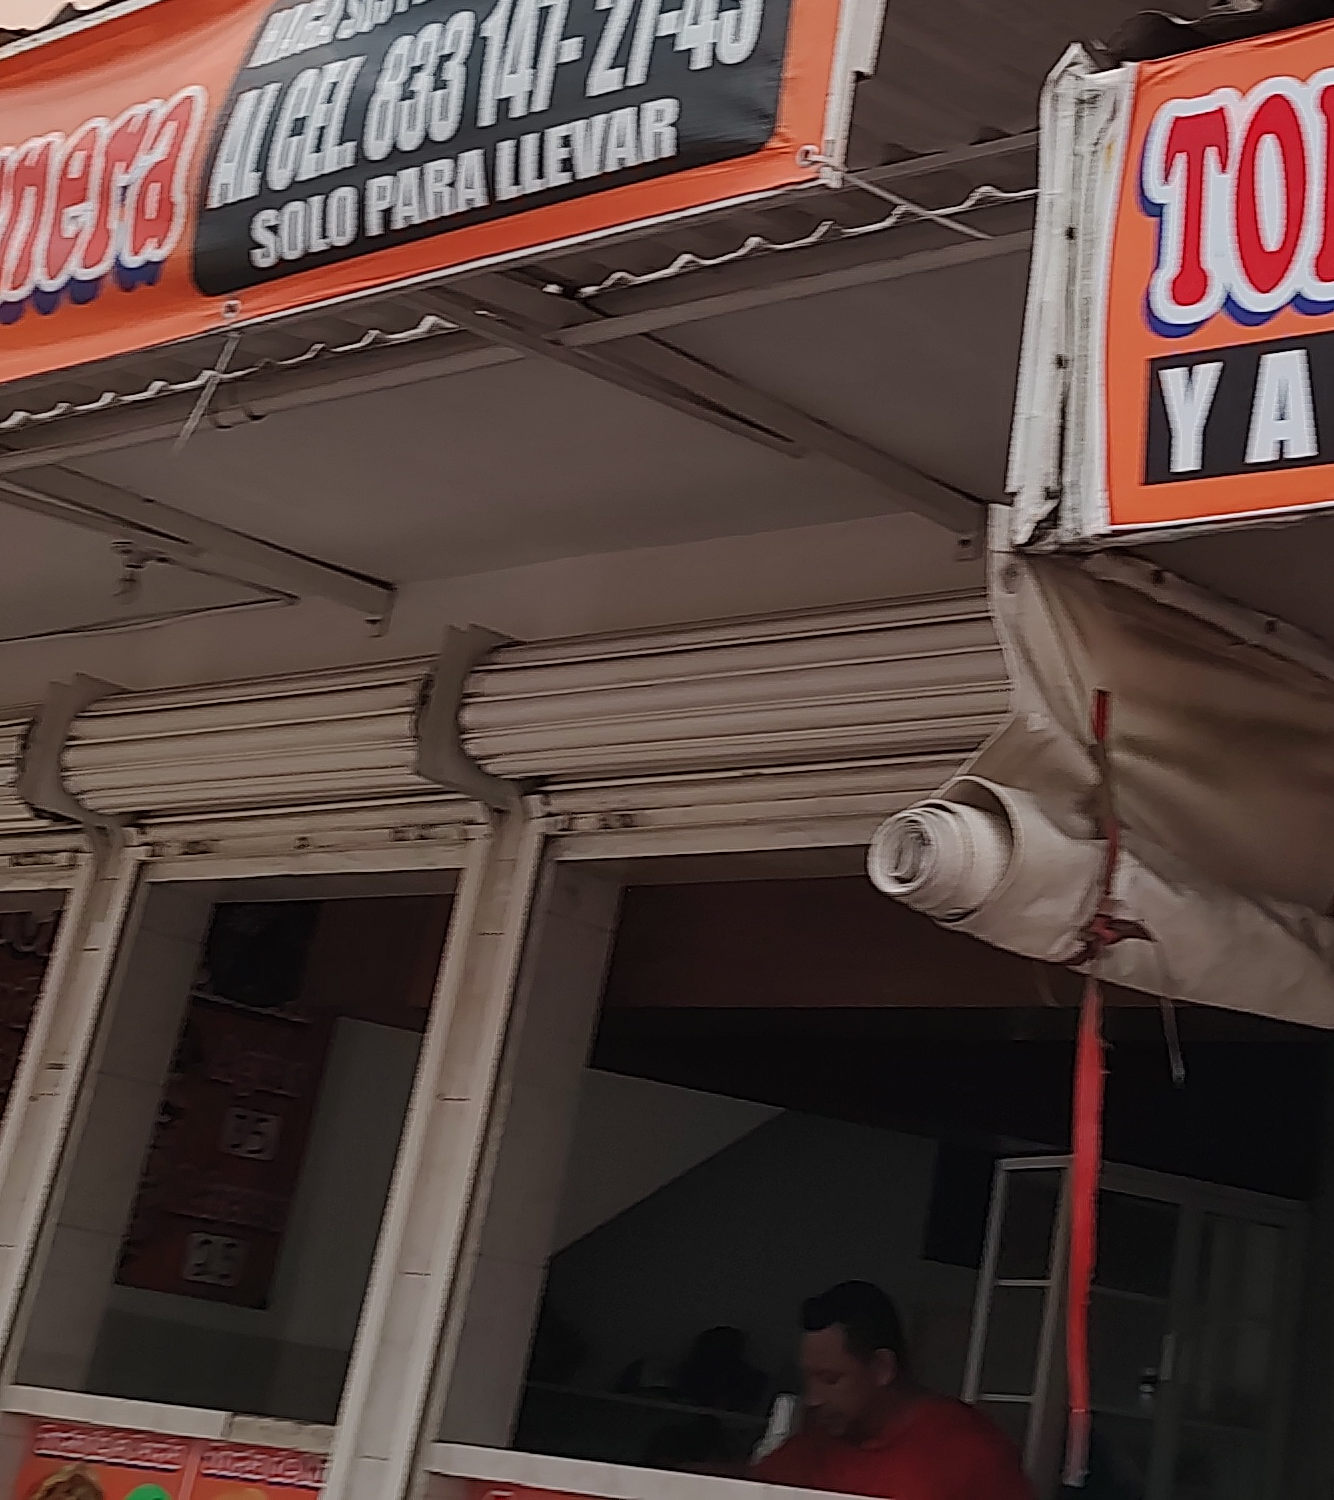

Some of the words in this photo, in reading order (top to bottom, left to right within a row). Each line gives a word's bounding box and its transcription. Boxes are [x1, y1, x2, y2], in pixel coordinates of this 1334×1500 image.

[206, 82, 282, 211] AL
[363, 10, 476, 160] 833
[249, 186, 359, 268] SOLO
[363, 148, 491, 237] PARA
[493, 97, 681, 201] LLEVAR
[1157, 347, 1320, 473] YA
